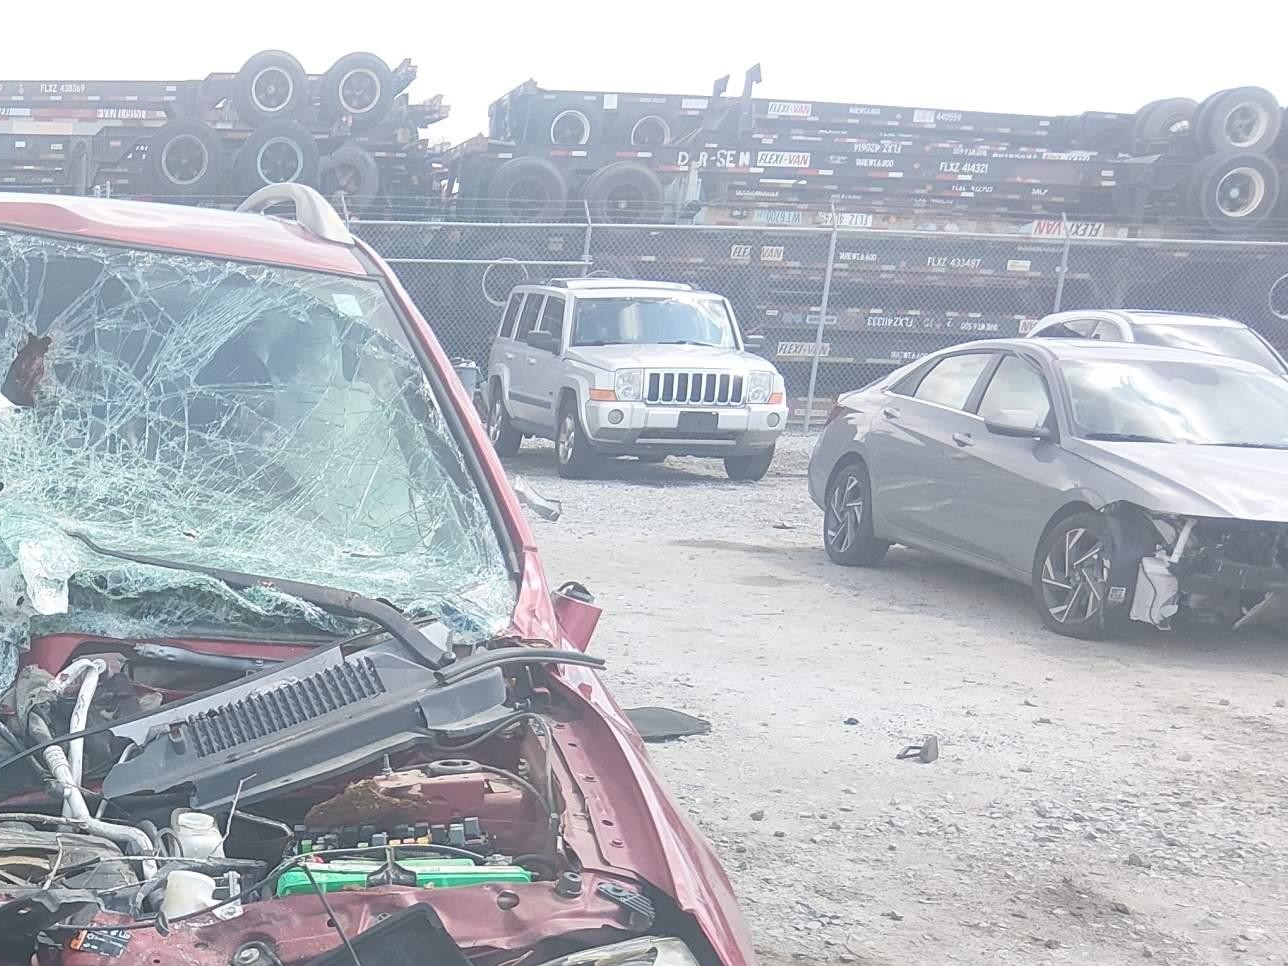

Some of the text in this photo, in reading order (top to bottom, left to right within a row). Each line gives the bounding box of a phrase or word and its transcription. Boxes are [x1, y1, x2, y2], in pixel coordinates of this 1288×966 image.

[40, 84, 58, 92] FLXZ
[770, 103, 809, 113] FLEXI-VAN
[882, 144, 901, 154] FLXZ
[759, 154, 808, 166] FLEXI-VAN
[939, 162, 988, 173] FLXZ 414321
[928, 256, 947, 266] FLXZ
